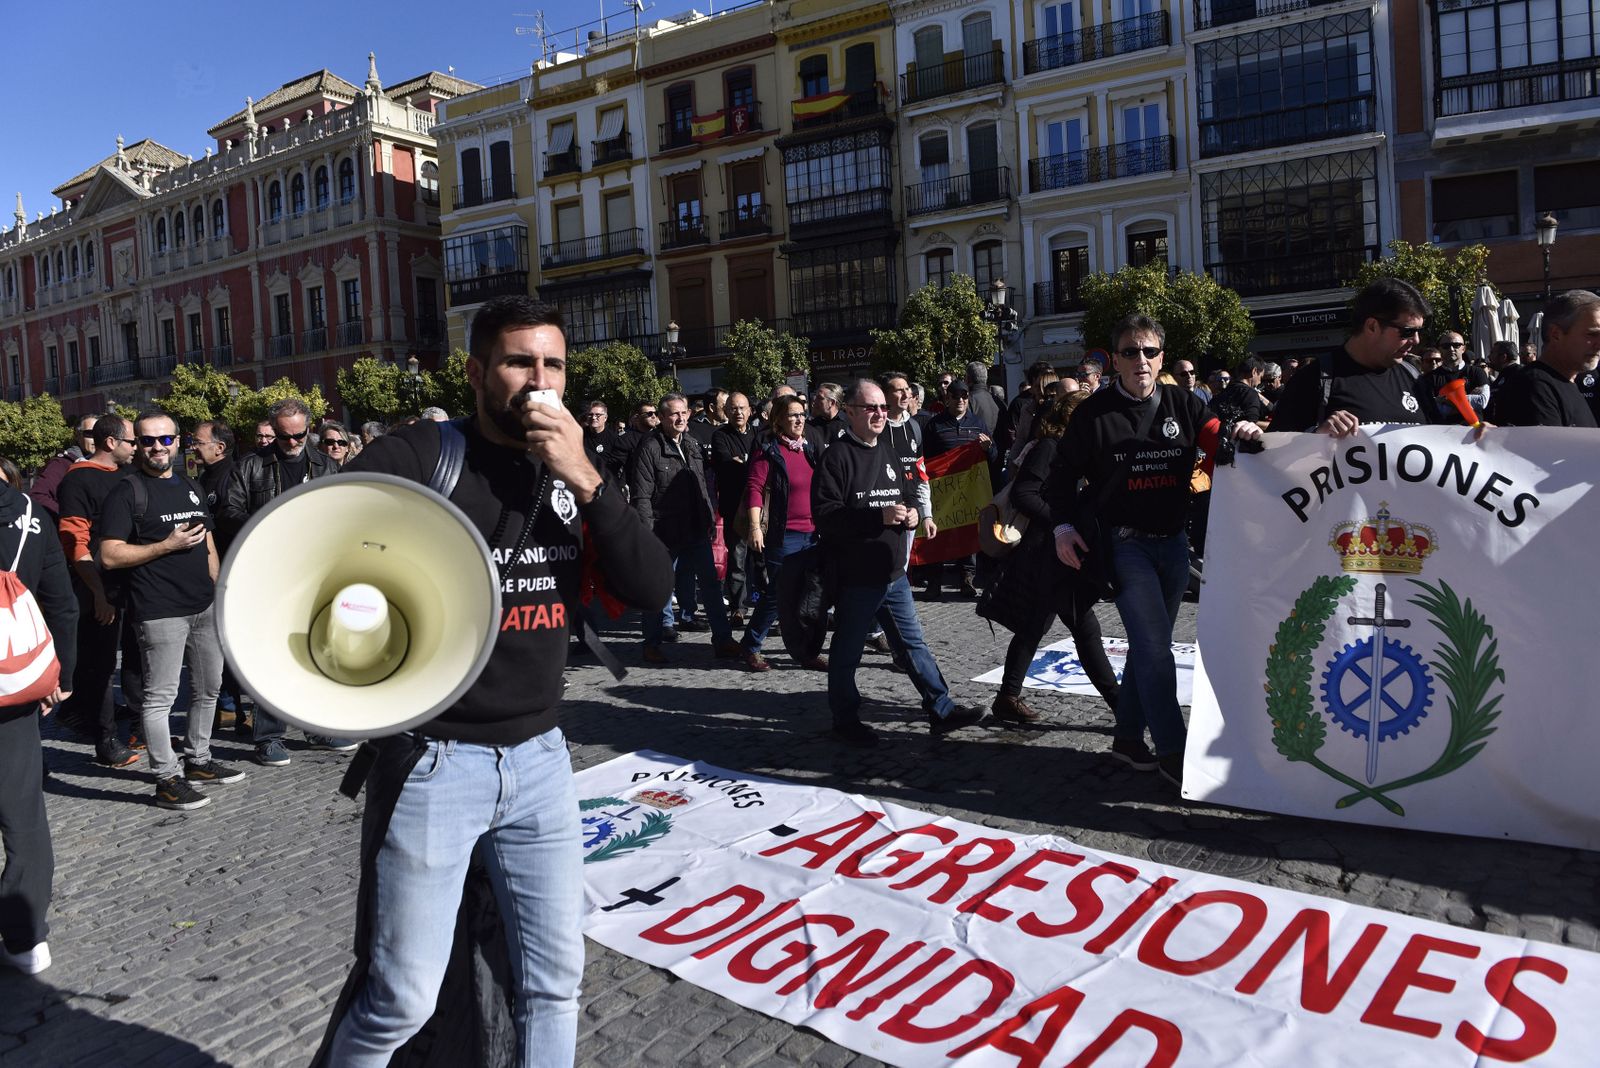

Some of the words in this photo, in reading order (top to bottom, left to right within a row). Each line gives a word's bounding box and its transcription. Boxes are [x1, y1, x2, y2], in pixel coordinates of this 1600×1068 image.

[812, 351, 826, 362] EL
[1127, 475, 1177, 491] MATAR
[1281, 443, 1540, 528] PRISIONES
[160, 514, 172, 522] TU
[936, 506, 980, 528] ANCHA
[517, 576, 557, 592] PUEDE
[500, 602, 566, 632] ATAR
[631, 770, 765, 809] PRISIONES
[758, 810, 1569, 1063] AGRESIONES
